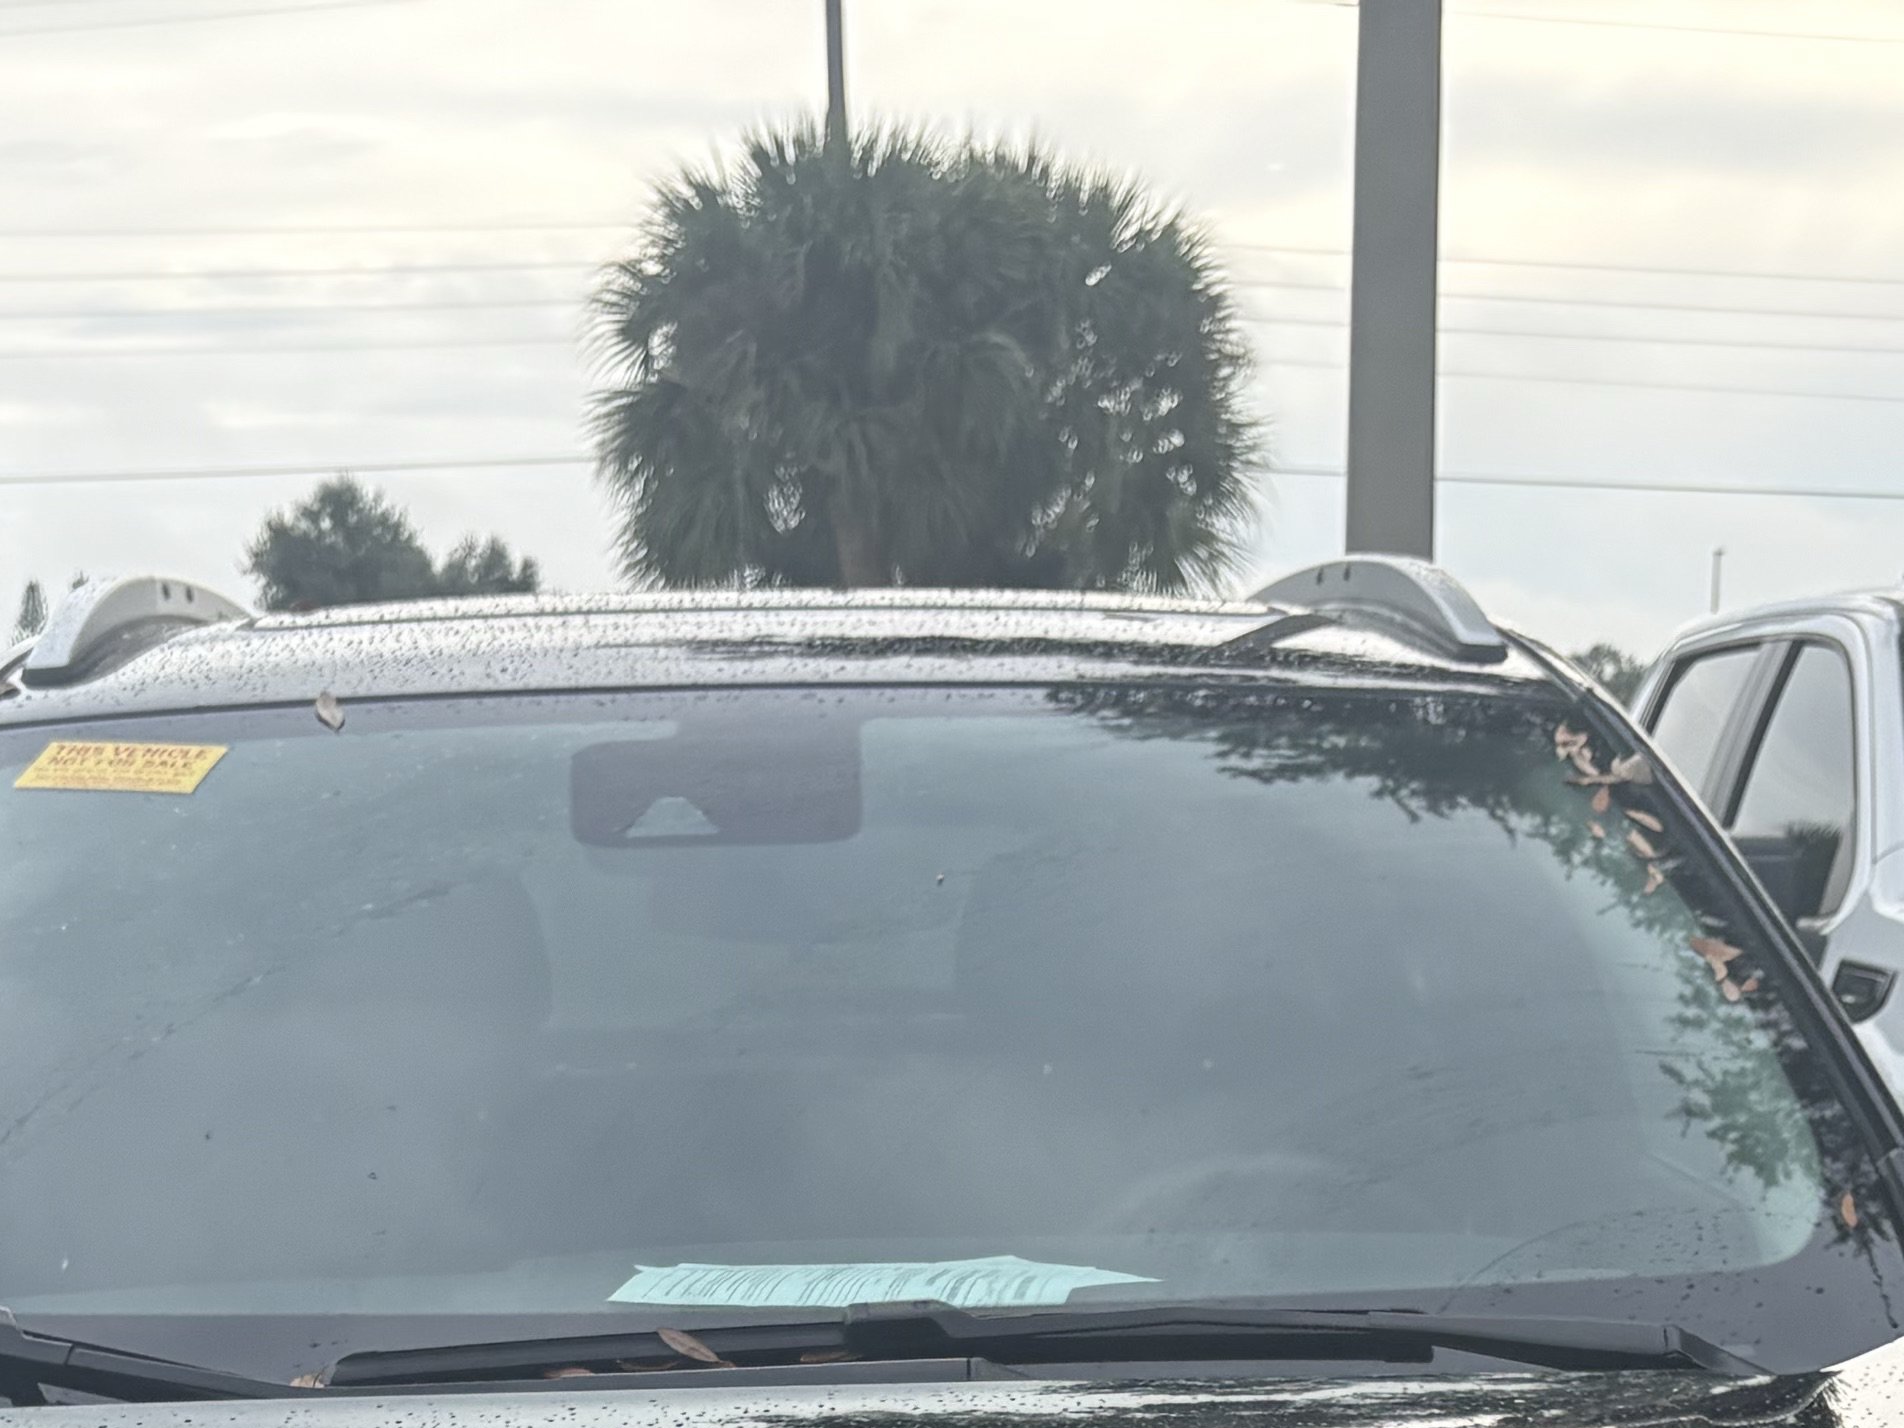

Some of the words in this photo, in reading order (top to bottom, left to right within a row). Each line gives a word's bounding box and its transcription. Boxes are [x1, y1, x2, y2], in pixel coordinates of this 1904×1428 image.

[55, 744, 105, 756] THIS
[113, 745, 213, 759] VEHICLE
[47, 755, 86, 766] NOT
